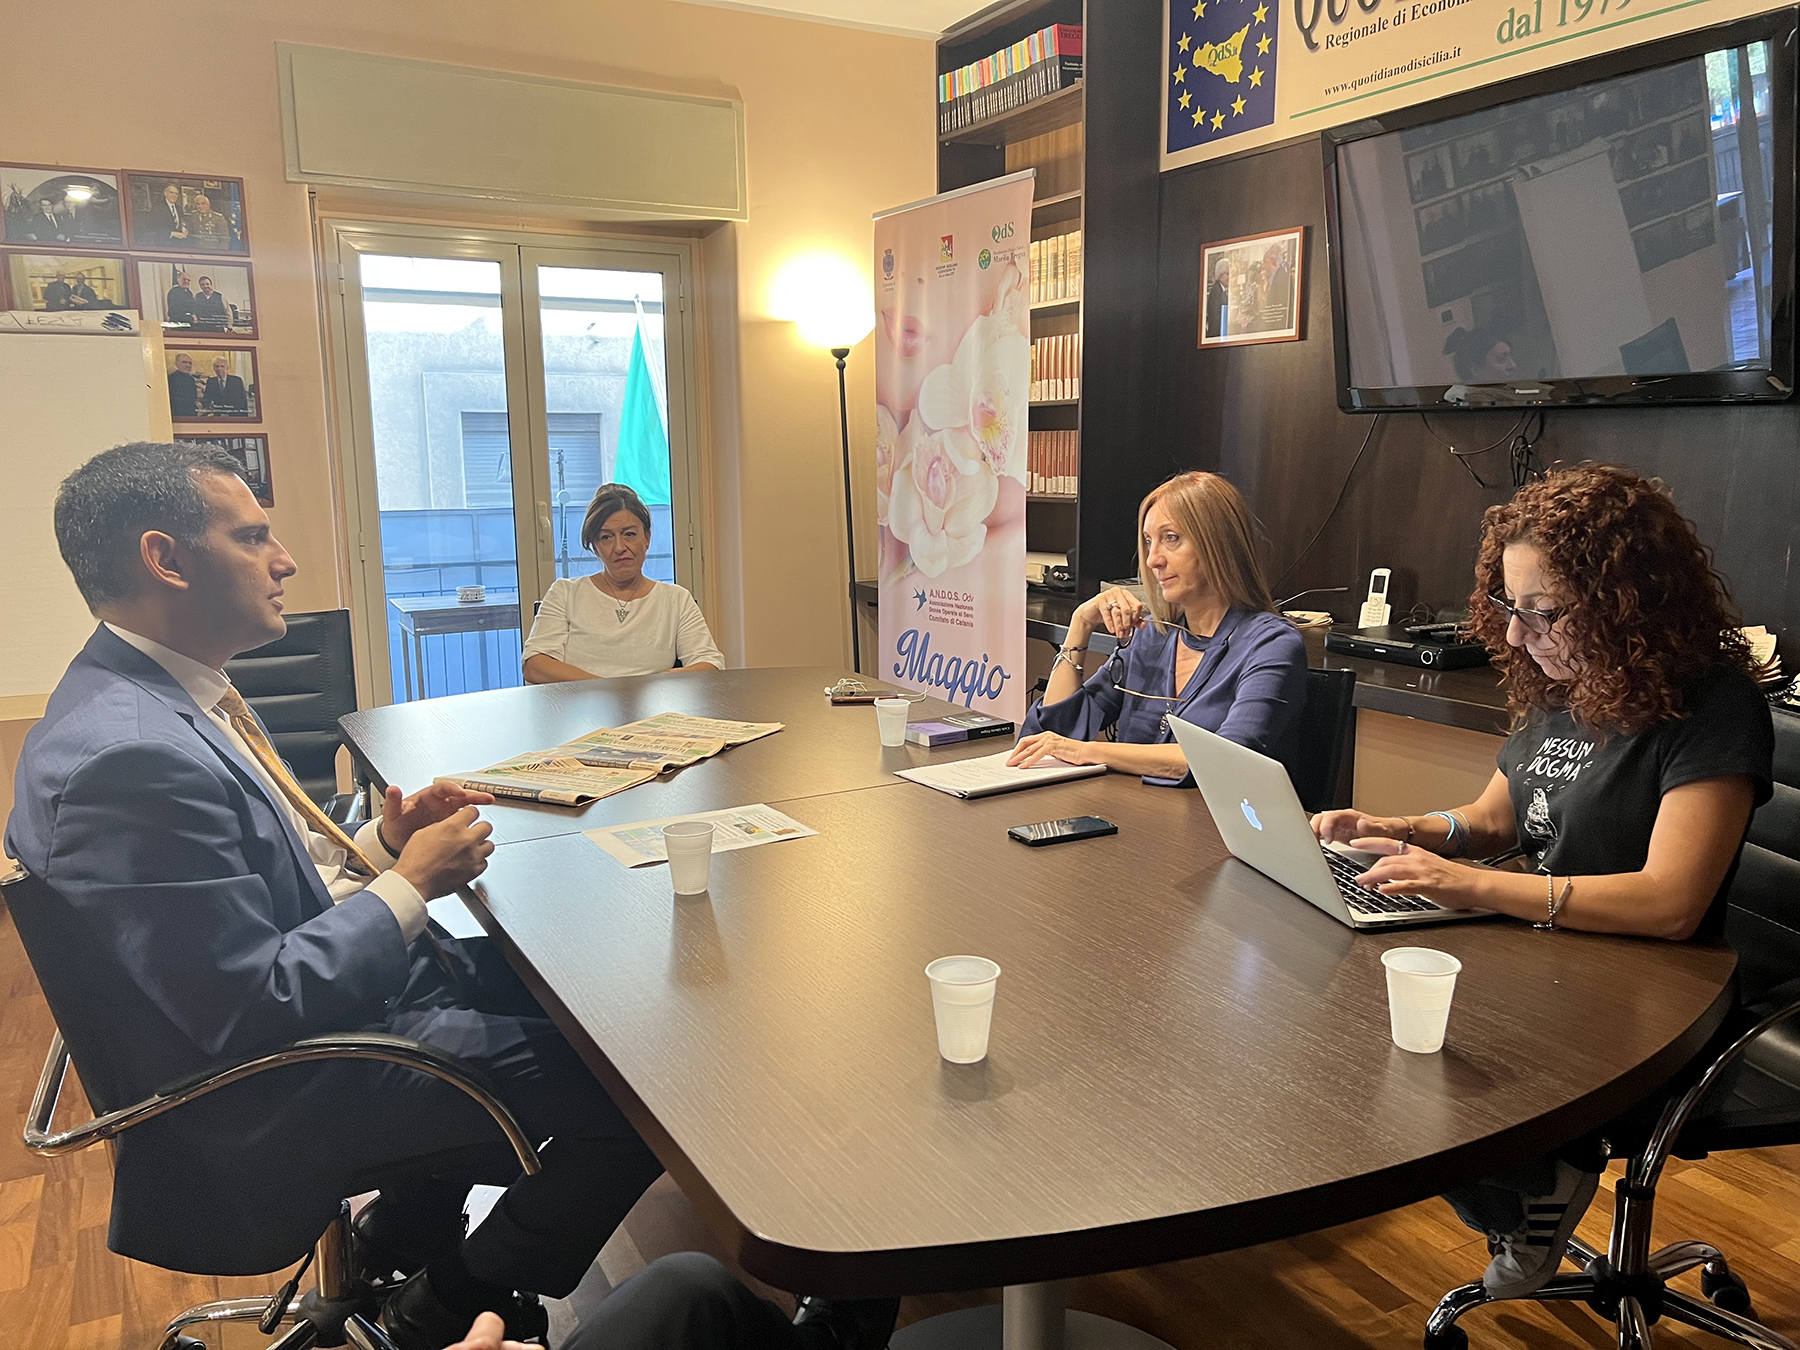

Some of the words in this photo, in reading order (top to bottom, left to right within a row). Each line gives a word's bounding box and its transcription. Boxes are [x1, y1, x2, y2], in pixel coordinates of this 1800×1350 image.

[1325, 17, 1389, 49] Regionale
[1393, 8, 1406, 27] di
[1496, 0, 1541, 44] dal
[1324, 46, 1462, 96] www.quotidianodisicilia.it
[991, 221, 1014, 244] QdS
[893, 629, 1012, 709] Maggio
[1526, 756, 1582, 781] DOGMA
[1536, 737, 1595, 760] NESSUN
